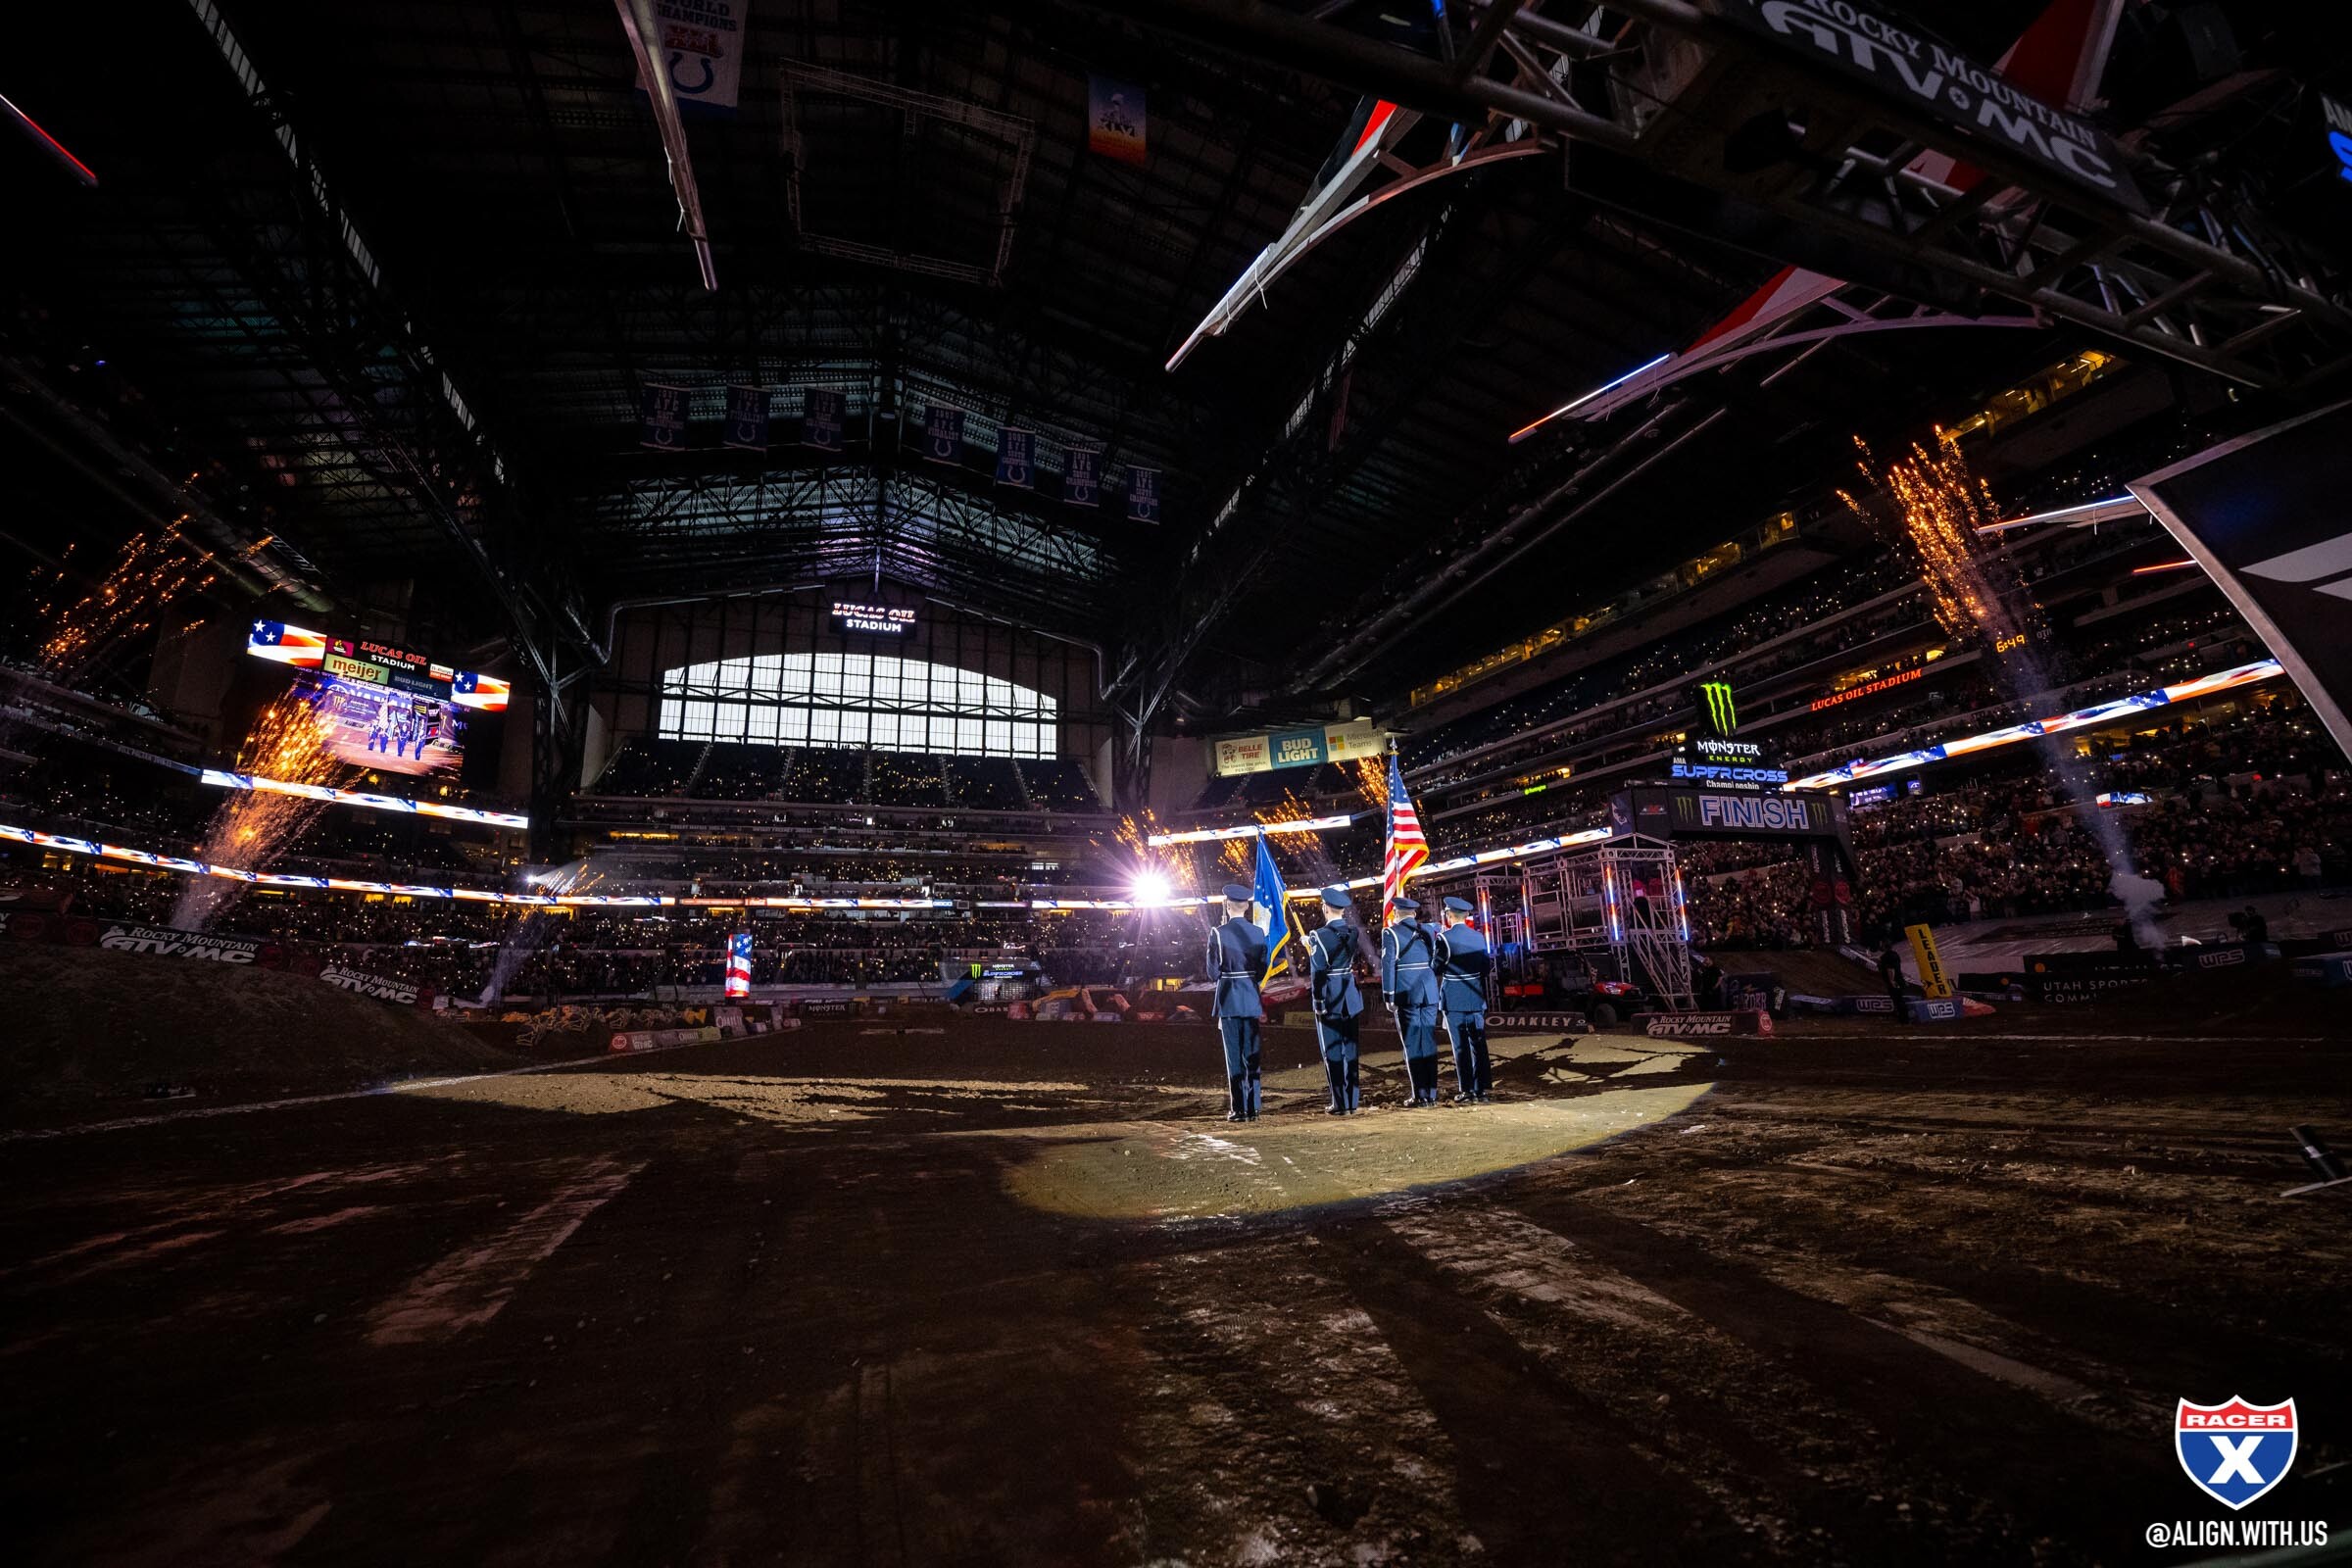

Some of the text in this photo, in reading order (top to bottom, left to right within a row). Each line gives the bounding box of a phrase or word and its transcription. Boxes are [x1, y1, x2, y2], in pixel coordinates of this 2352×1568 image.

[1929, 43, 2097, 151] MOUNTAIN
[832, 603, 915, 623] LUCAS OIL
[846, 618, 902, 632] STADIUM
[360, 641, 427, 665] LUCAS OIL
[1996, 634, 2025, 654] 6:49
[333, 658, 382, 681] meijer
[370, 654, 415, 671] STADIUM
[1810, 695, 1843, 712] LUCAS
[1845, 688, 1864, 702] OIL
[1865, 668, 1922, 695] STADIUM
[1281, 738, 1312, 751] BUD
[1348, 740, 1373, 749] Teams
[1696, 740, 1761, 756] MONSTER
[1278, 747, 1318, 763] LIGHT
[1709, 755, 1753, 763] ENERGY
[1672, 764, 1788, 782] SUPERCROSS
[1698, 795, 1809, 829] FINISH
[129, 926, 259, 952] ROCKY MOUNTAIN
[1917, 928, 1947, 995] LEADER
[2198, 949, 2245, 968] WPS
[338, 967, 419, 993] ROCKY MOUNTAIN
[2043, 980, 2082, 991] UTAH
[1857, 998, 1894, 1012] WPS
[1927, 1001, 1955, 1019] WPS
[1506, 1016, 1571, 1027] OAKLEY
[1660, 1014, 1732, 1024] ROCKY MOUNTAIN
